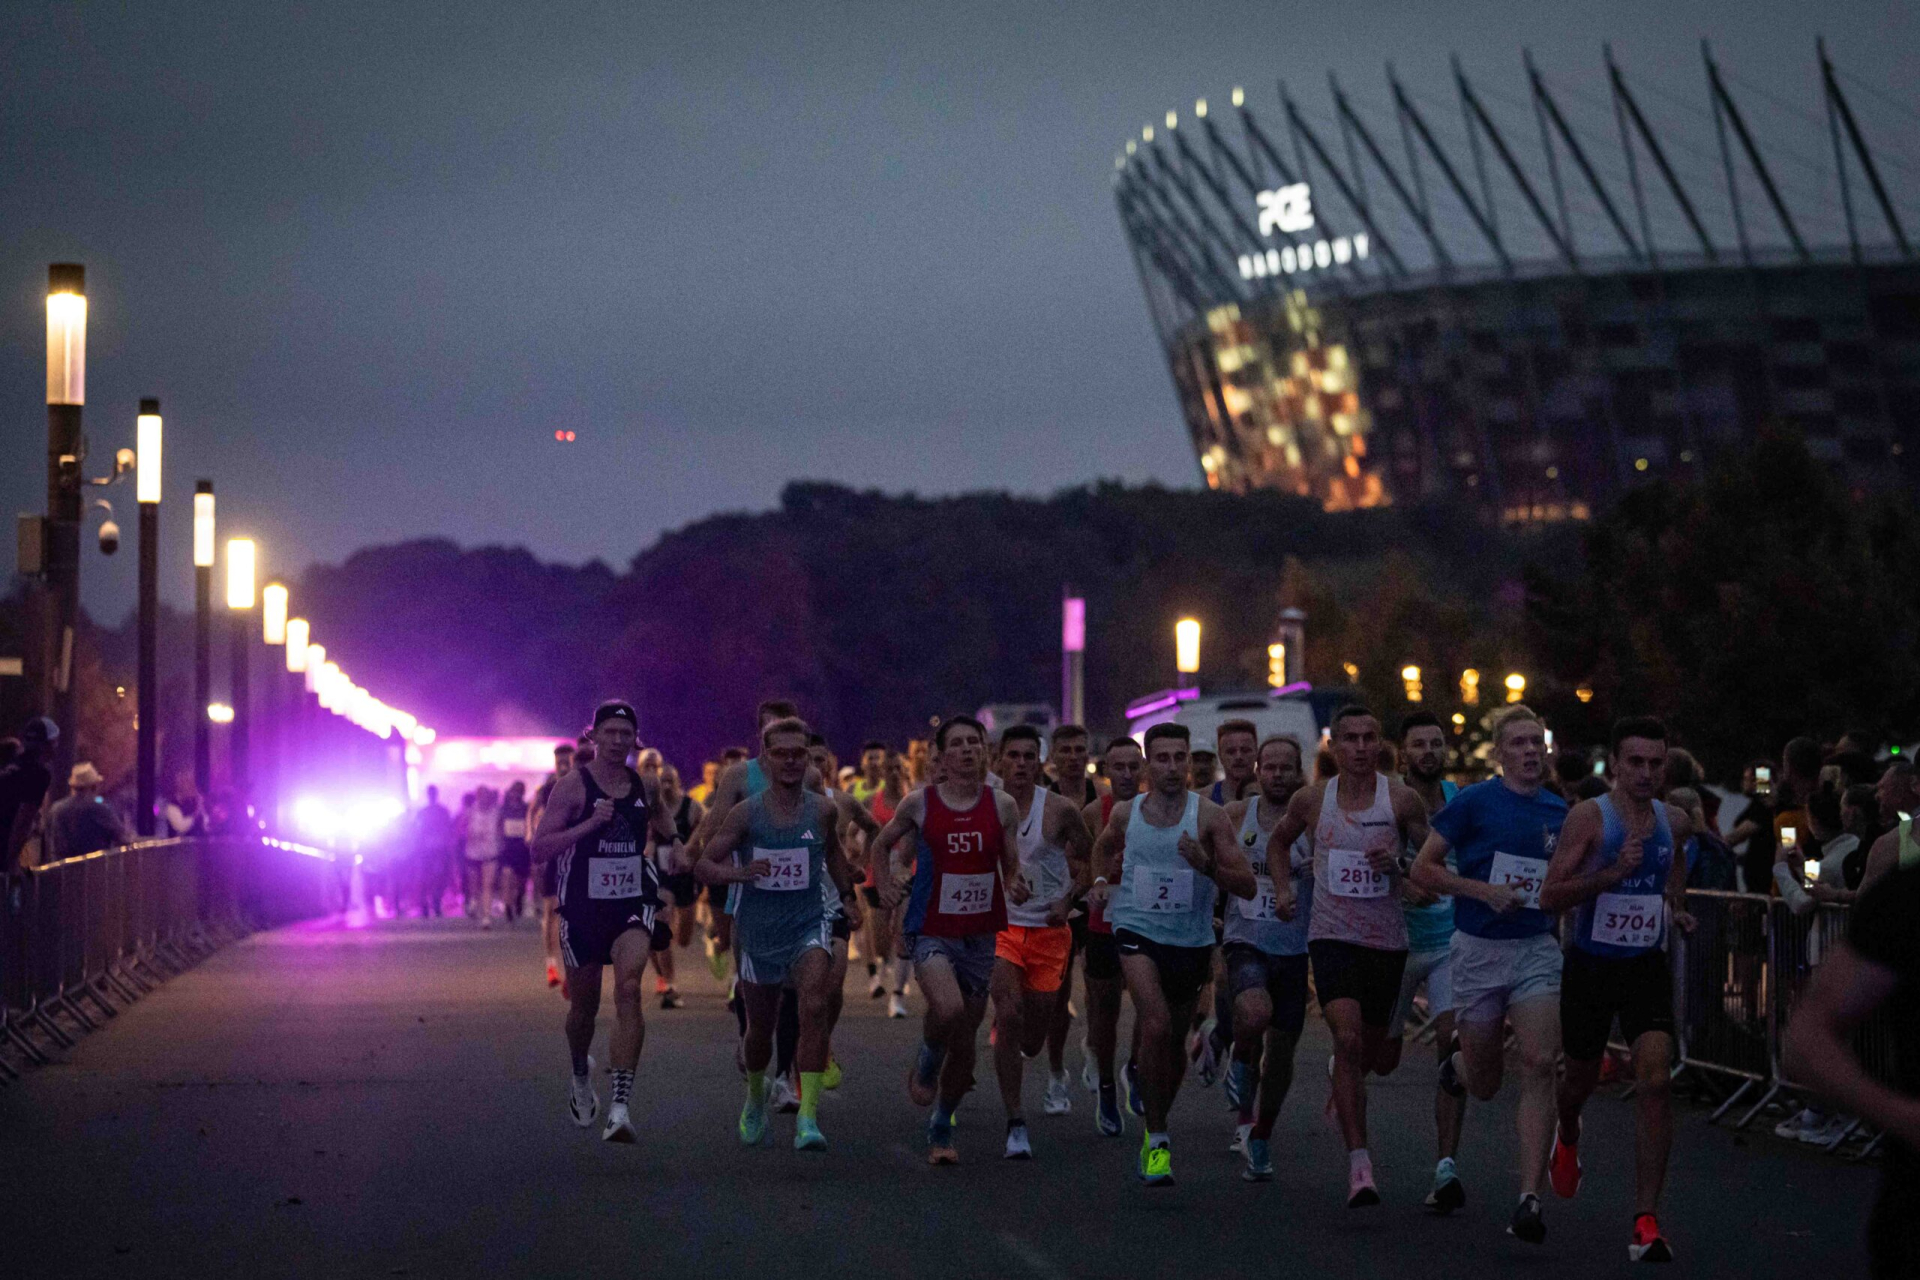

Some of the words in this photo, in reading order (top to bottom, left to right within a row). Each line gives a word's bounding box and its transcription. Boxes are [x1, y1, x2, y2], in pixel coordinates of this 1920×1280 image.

[947, 831, 983, 854] 557
[772, 864, 802, 877] 743
[601, 873, 634, 886] 3174
[951, 888, 988, 902] 4215
[1158, 886, 1168, 899] 2
[1605, 913, 1656, 931] 3704
